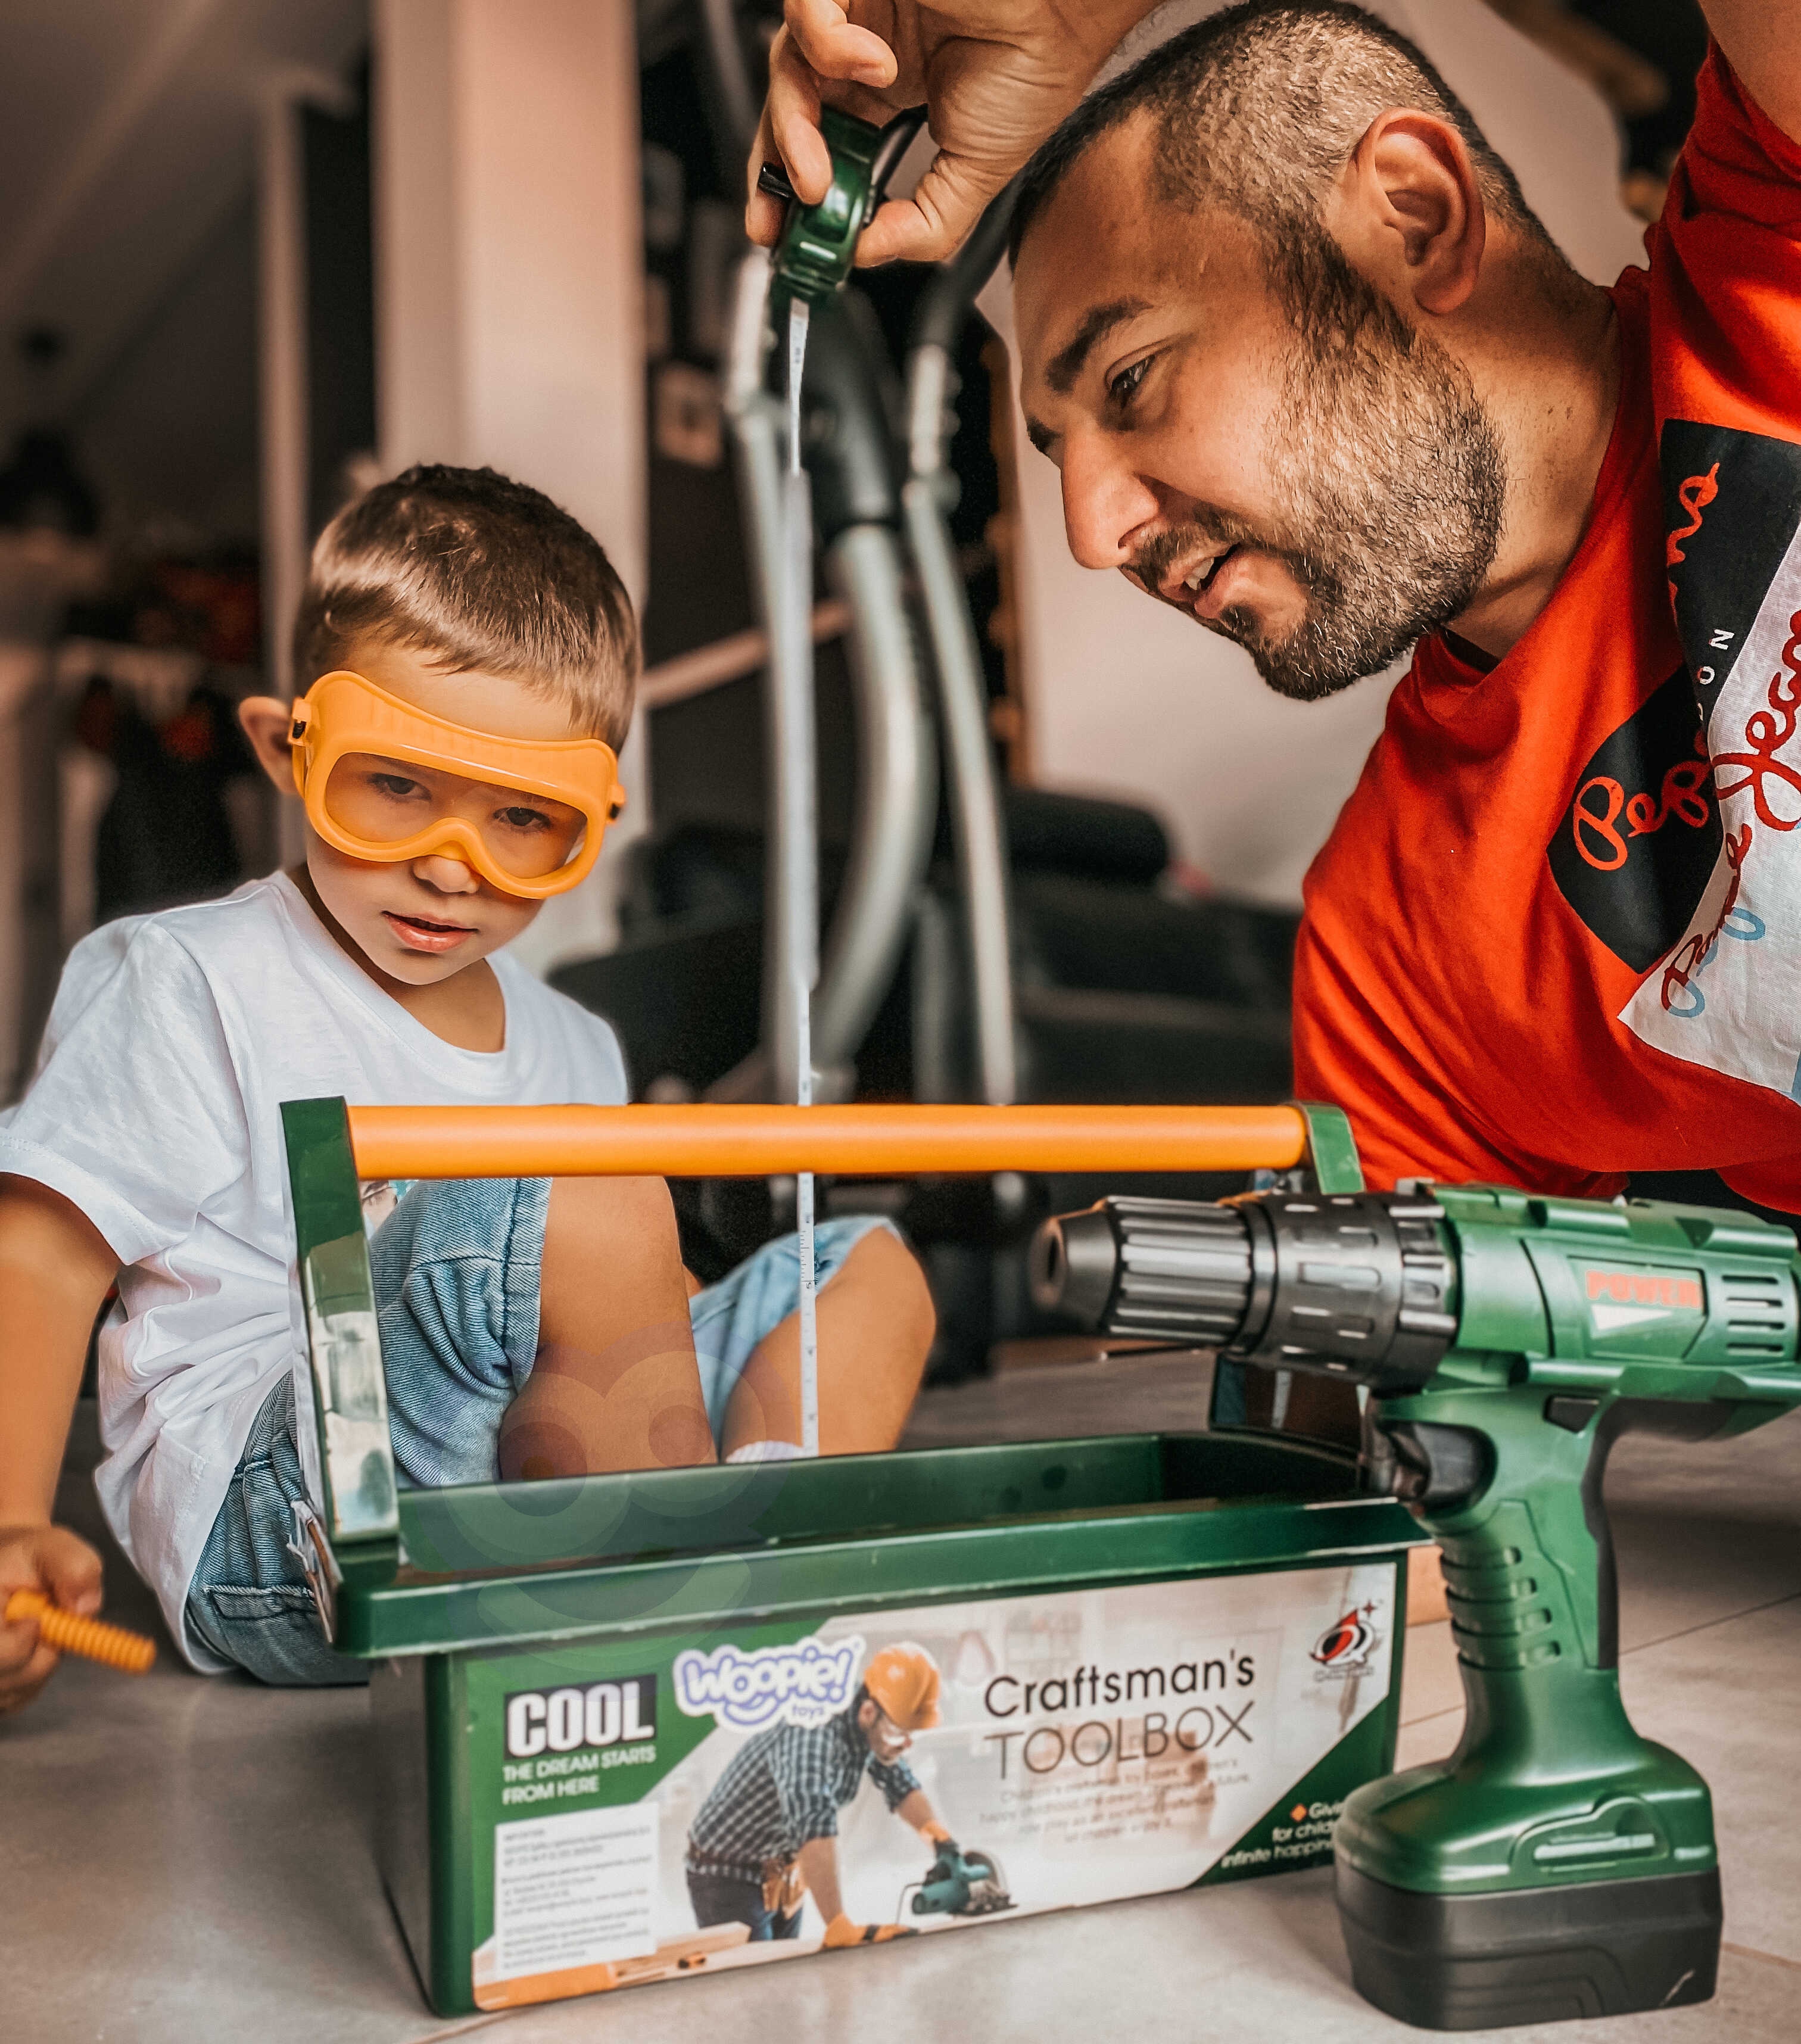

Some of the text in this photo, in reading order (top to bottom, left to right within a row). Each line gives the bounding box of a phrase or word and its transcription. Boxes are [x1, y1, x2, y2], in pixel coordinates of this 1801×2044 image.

[1585, 1269, 1703, 1309] POWER
[984, 1648, 1255, 1718] Craftsman's
[507, 1681, 655, 1758] COOL
[791, 1704, 825, 1719] toys
[983, 1700, 1255, 1780] TOOLBOX
[503, 1744, 656, 1783] THE DREAM STARTS
[501, 1774, 600, 1805] FROM HERE
[1272, 1827, 1293, 1842] for
[1221, 1847, 1272, 1868] infinite
